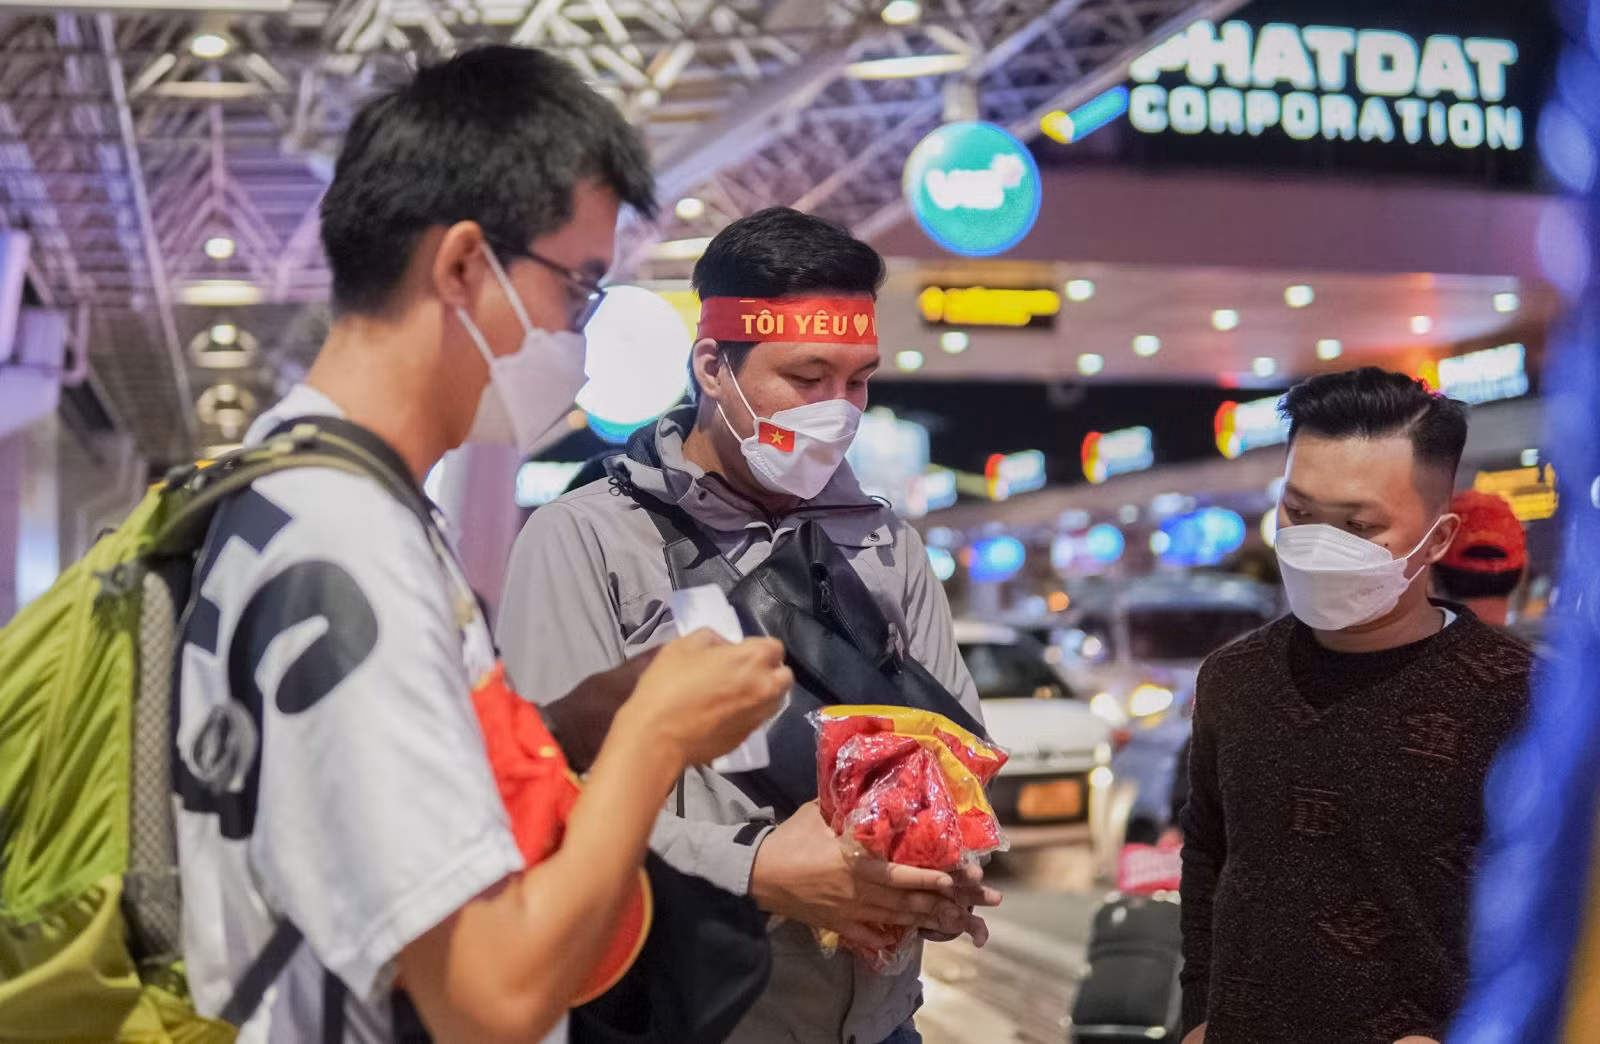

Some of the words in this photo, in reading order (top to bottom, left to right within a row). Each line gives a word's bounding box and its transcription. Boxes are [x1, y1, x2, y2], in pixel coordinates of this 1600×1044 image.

[1129, 84, 1523, 150] CORPORATION
[741, 309, 784, 335] TÔI
[794, 309, 848, 336] YÊU
